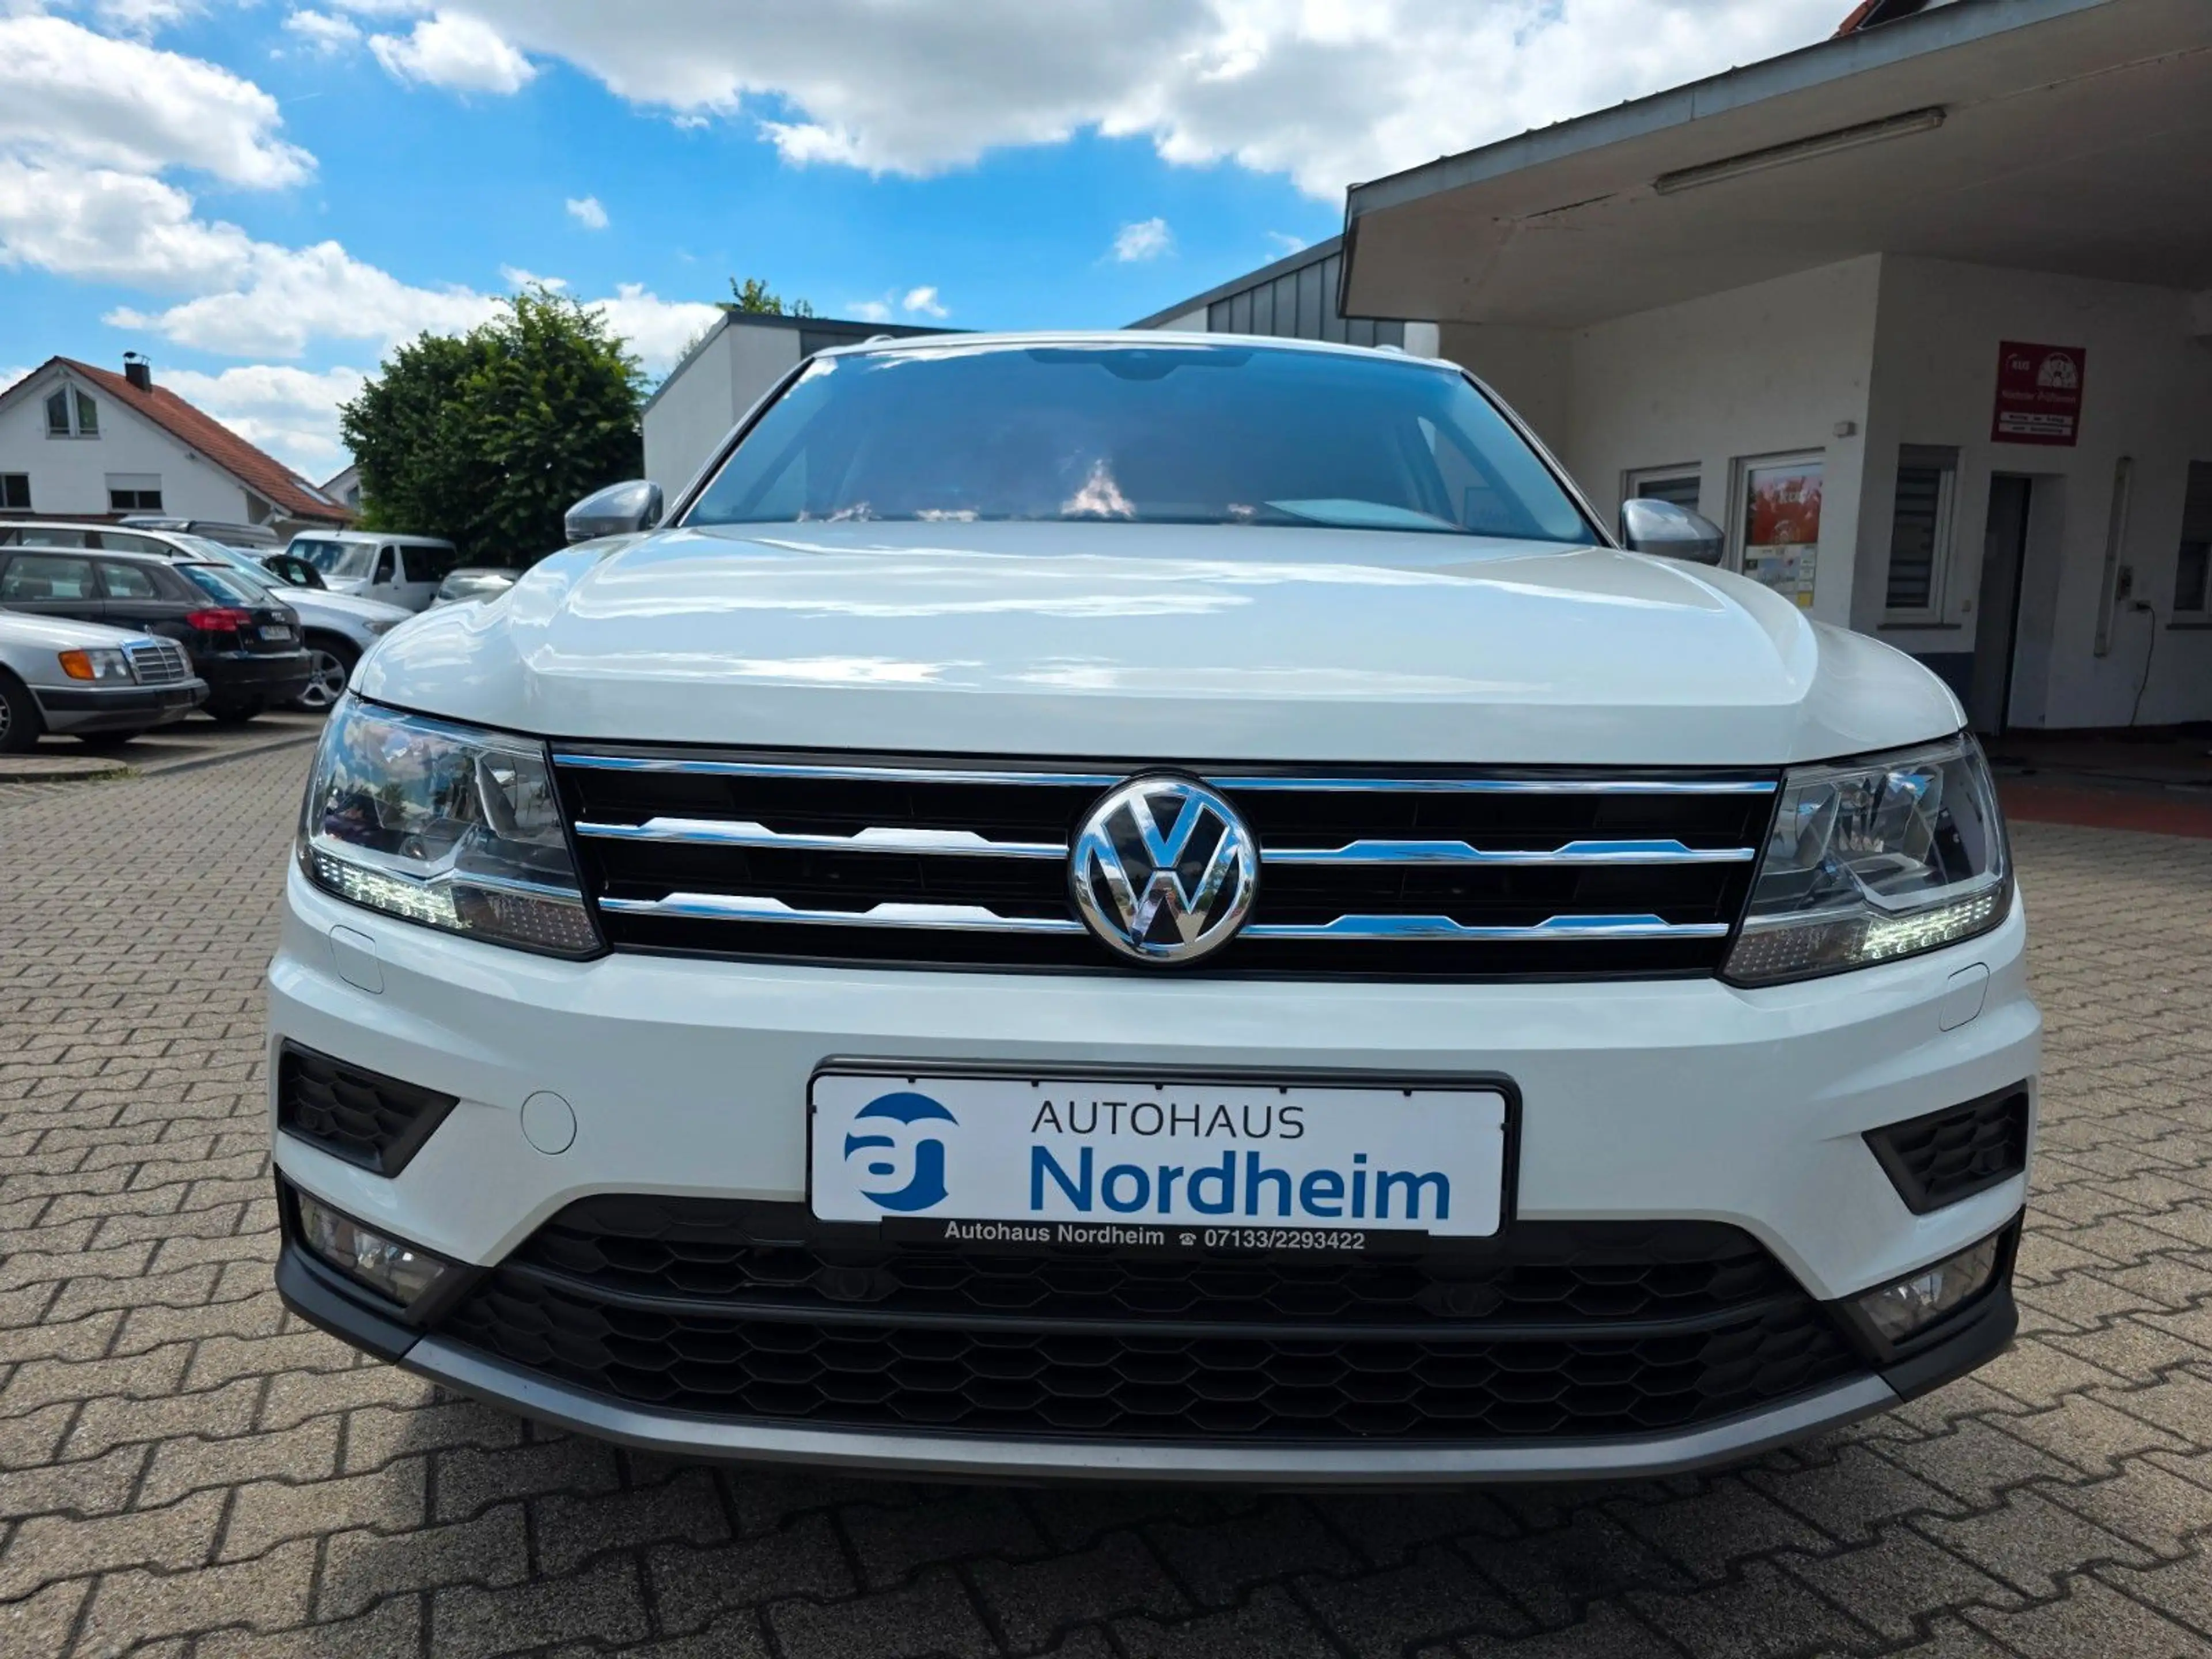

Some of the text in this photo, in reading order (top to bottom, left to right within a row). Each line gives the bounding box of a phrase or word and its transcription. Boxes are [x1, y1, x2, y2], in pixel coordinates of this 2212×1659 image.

[1083, 786, 1248, 955] VW
[1031, 1100, 1305, 1140] AUTOHAUS
[1029, 1145, 1451, 1220] Nordheim
[944, 1220, 1366, 1250] Autohaus Nordheim 07133/2293422
